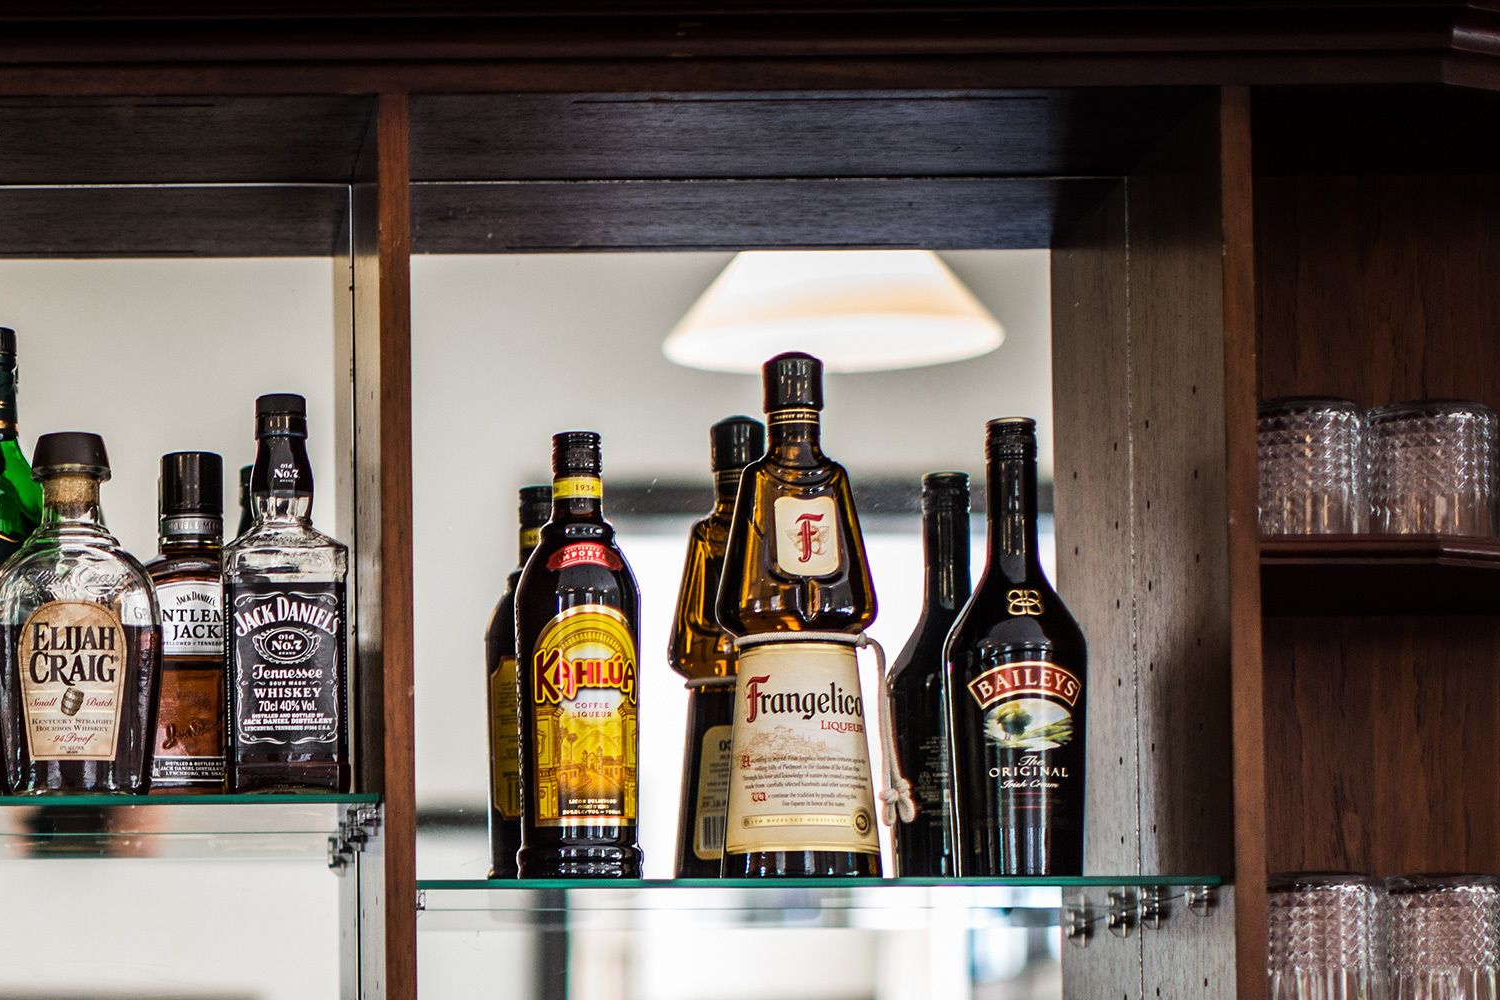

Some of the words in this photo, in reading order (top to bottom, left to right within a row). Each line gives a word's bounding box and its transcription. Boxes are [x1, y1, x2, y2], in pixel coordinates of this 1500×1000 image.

[795, 513, 824, 563] F
[176, 592, 192, 606] JACK
[192, 590, 216, 607] DANIEL'S
[234, 603, 278, 638] JACK
[277, 596, 341, 638] DANIEL'S
[32, 622, 116, 654] ELIJAH
[30, 650, 116, 686] CRAIG
[252, 664, 323, 680] Tennessee
[535, 648, 638, 705] KAHLÚA
[976, 668, 1074, 699] BAILEYS
[254, 687, 321, 698] WHISKEY
[746, 674, 863, 724] Frangelico
[30, 697, 58, 706] Small
[86, 696, 113, 706] Batch
[258, 700, 278, 712] 70cl
[280, 700, 300, 712] 40%
[302, 700, 318, 712] Vol.
[820, 720, 864, 734] LIQUEUR
[64, 732, 96, 745] Proof
[1018, 755, 1044, 766] The
[988, 766, 1069, 778] ORIGINAL
[1000, 779, 1028, 790] Irish
[1030, 779, 1059, 789] Cream
